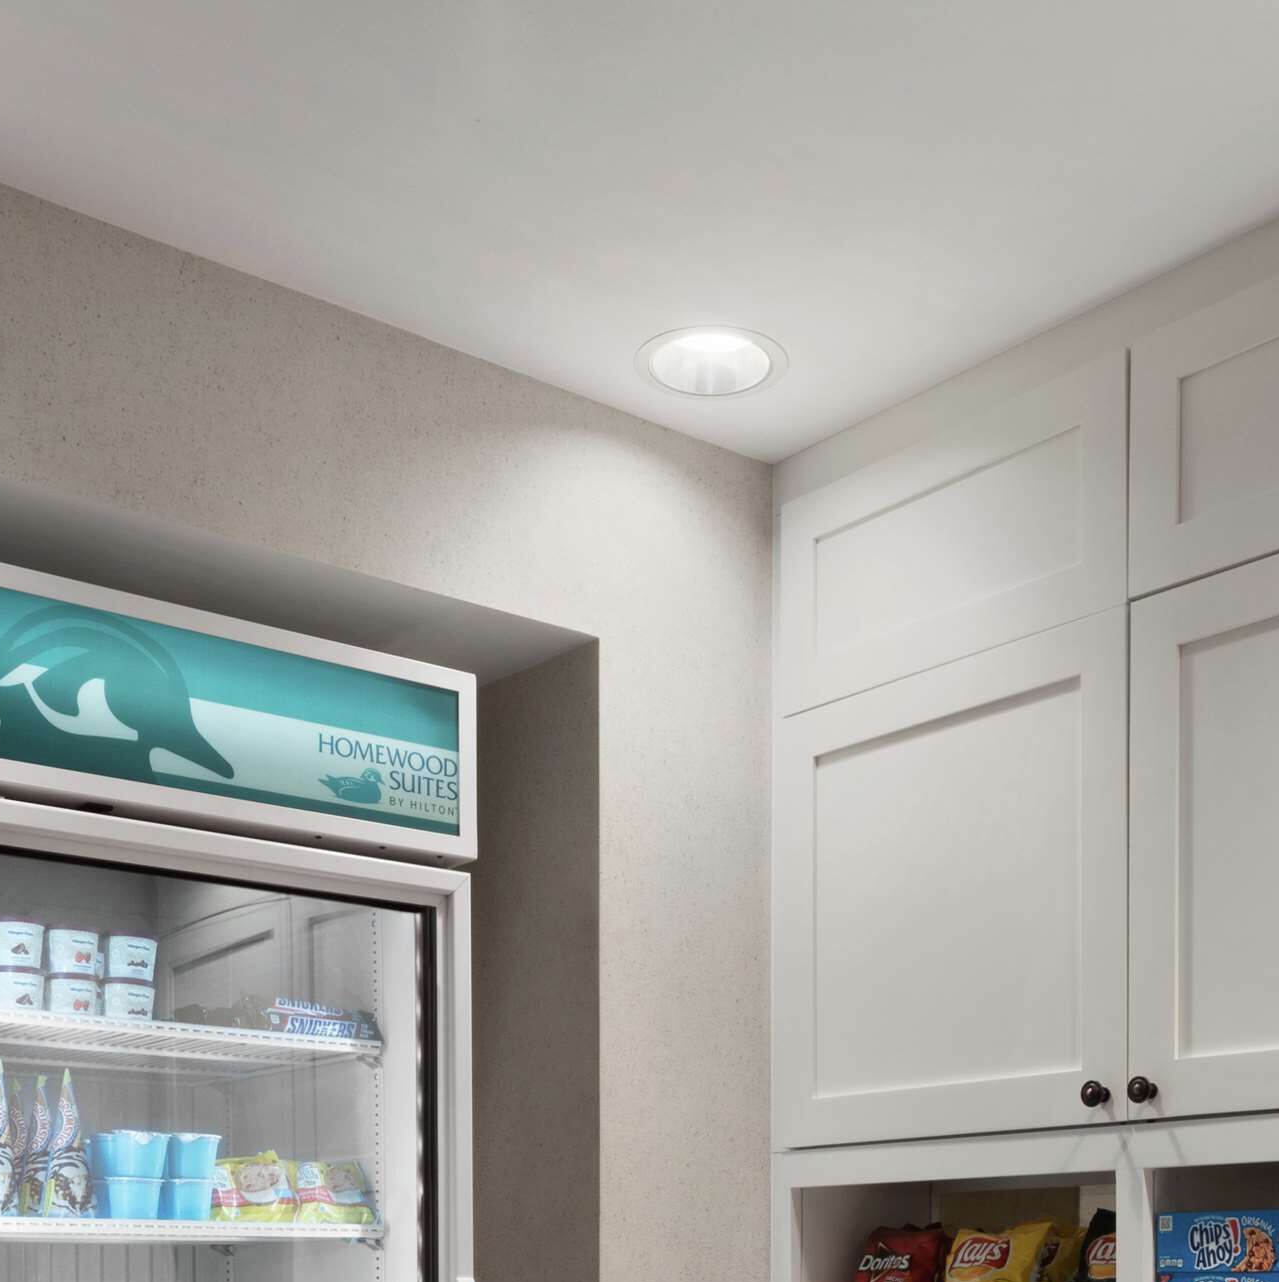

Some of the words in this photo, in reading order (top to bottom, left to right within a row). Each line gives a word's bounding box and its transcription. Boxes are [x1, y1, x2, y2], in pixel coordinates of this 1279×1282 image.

[319, 733, 458, 777] HOMEWOOD
[389, 770, 458, 801] SUITES
[389, 796, 404, 807] BY
[410, 801, 456, 816] HILTON
[1190, 1221, 1231, 1251] Chips
[1241, 1215, 1276, 1235] ORIGINAL
[858, 1254, 911, 1271] Doritos
[951, 1237, 1009, 1268] Lay's
